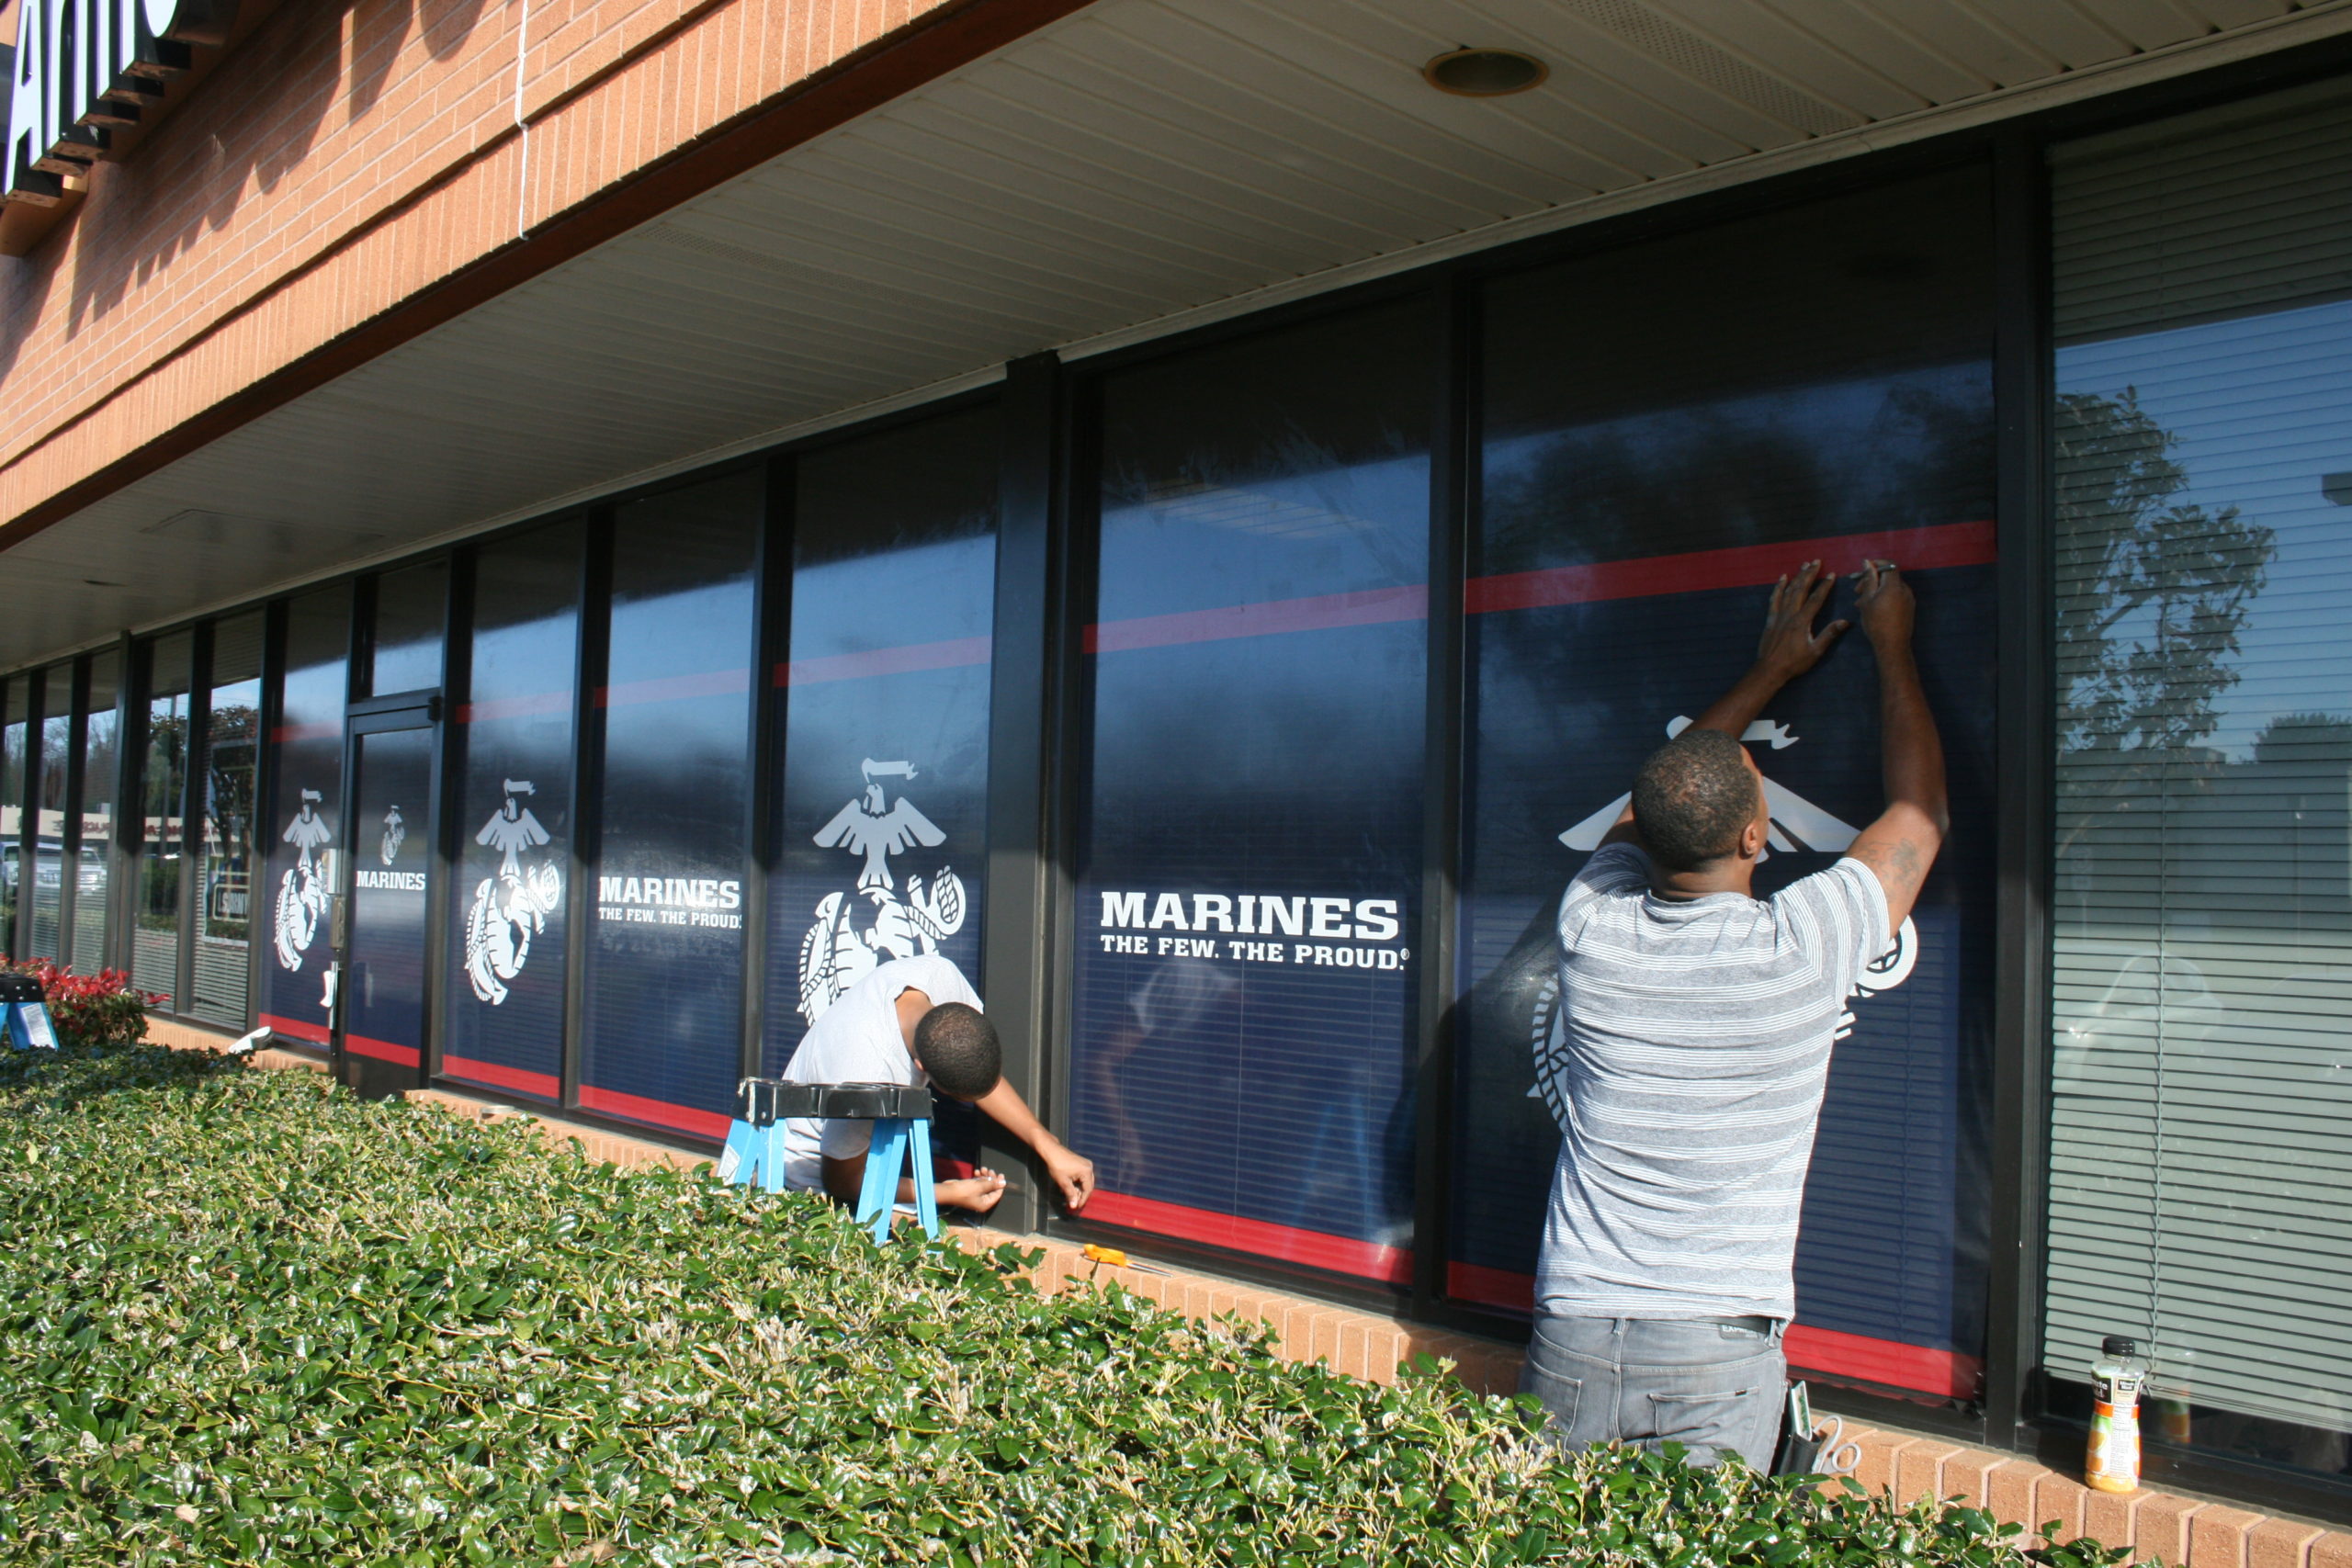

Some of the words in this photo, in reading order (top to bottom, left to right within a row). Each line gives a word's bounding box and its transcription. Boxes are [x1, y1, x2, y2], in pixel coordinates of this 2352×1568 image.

[356, 871, 426, 891] MARINES
[599, 876, 741, 909] MARINES
[599, 907, 622, 920] THE
[627, 908, 656, 922] FEW.
[661, 910, 686, 925] THE
[1101, 891, 1399, 941] MARINES
[1100, 934, 1148, 954] THE
[1158, 937, 1219, 959] FEW.
[1229, 940, 1284, 964] THE
